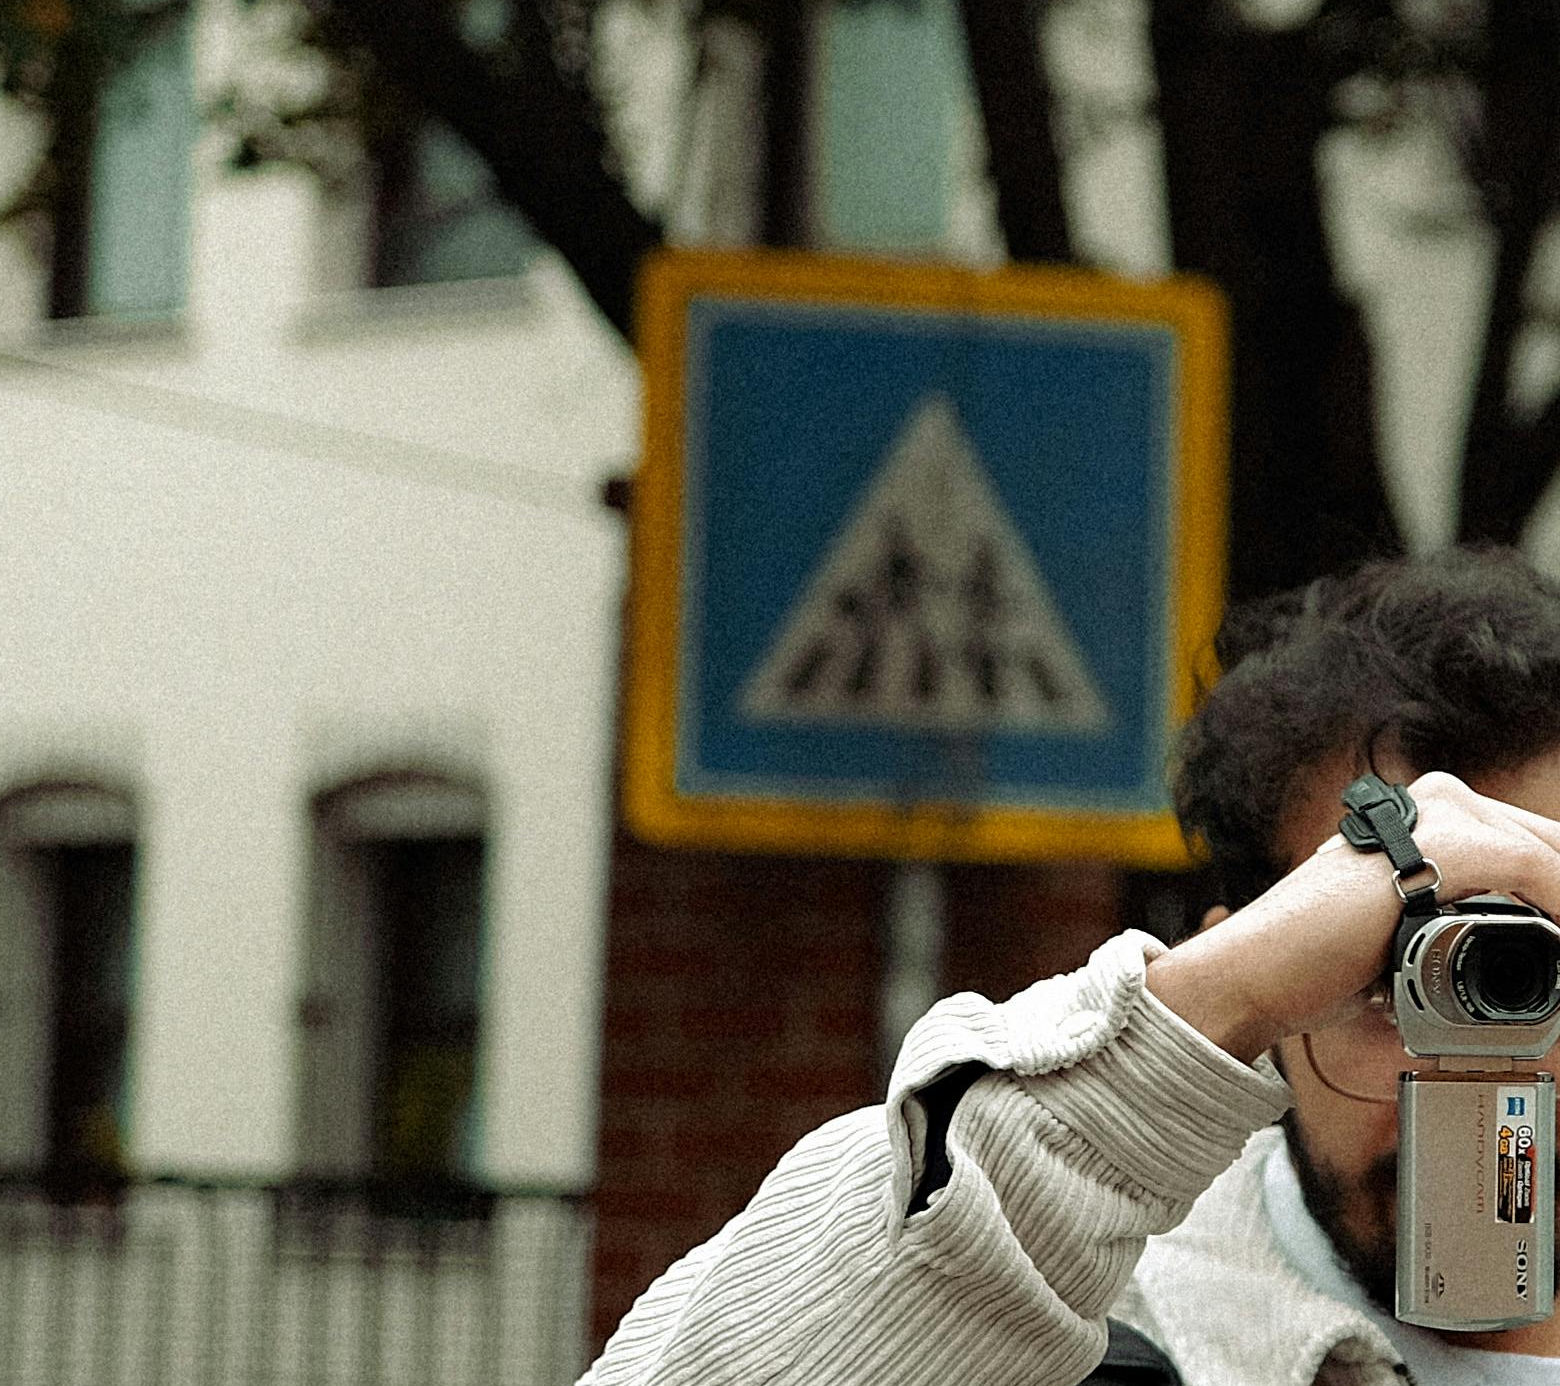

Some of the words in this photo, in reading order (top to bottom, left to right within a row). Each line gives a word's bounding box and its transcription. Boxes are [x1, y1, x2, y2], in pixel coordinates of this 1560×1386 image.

[1431, 948, 1442, 995] SONY
[1475, 1093, 1486, 1213] HANDYCAM
[1516, 1239, 1529, 1301] SONY
